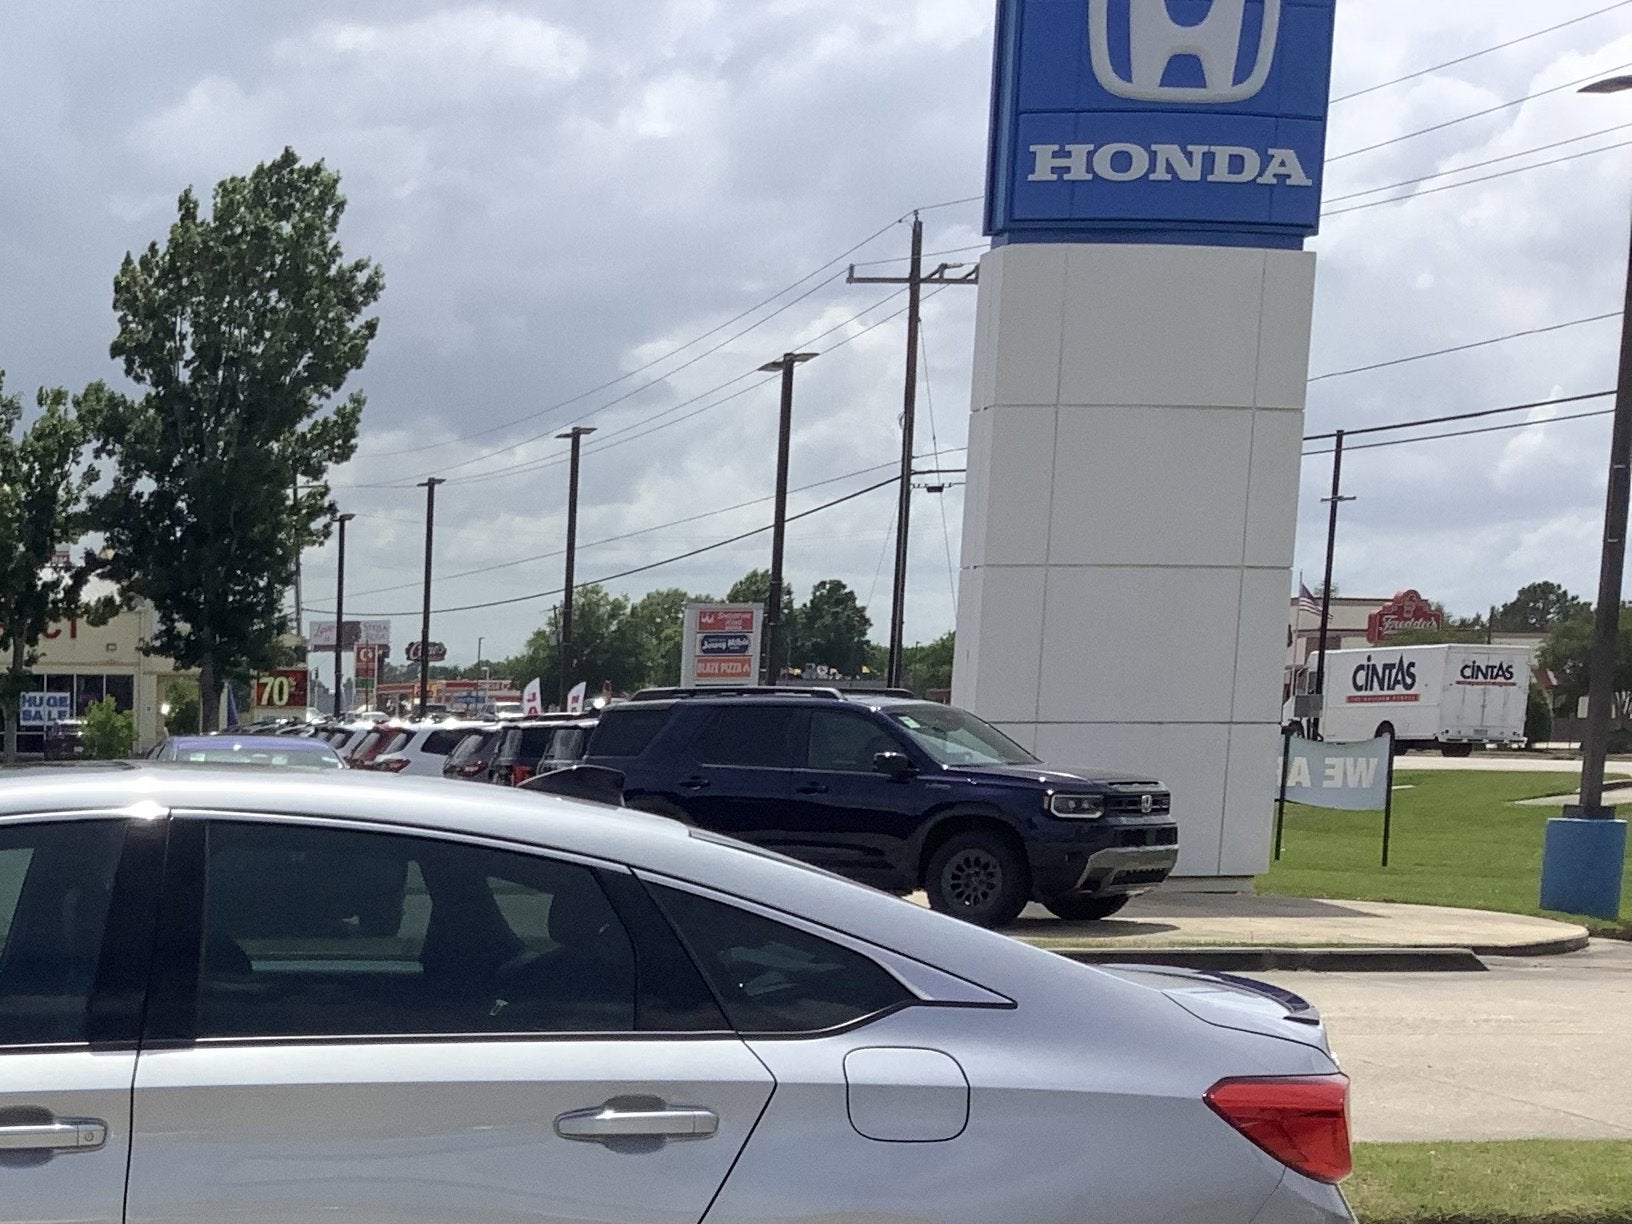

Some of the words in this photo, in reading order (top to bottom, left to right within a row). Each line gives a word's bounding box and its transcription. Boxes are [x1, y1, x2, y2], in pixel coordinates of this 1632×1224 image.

[1027, 143, 1313, 186] HONDA
[720, 662, 742, 673] PIZZA
[22, 696, 68, 707] HUGE
[22, 710, 68, 721] SALE
